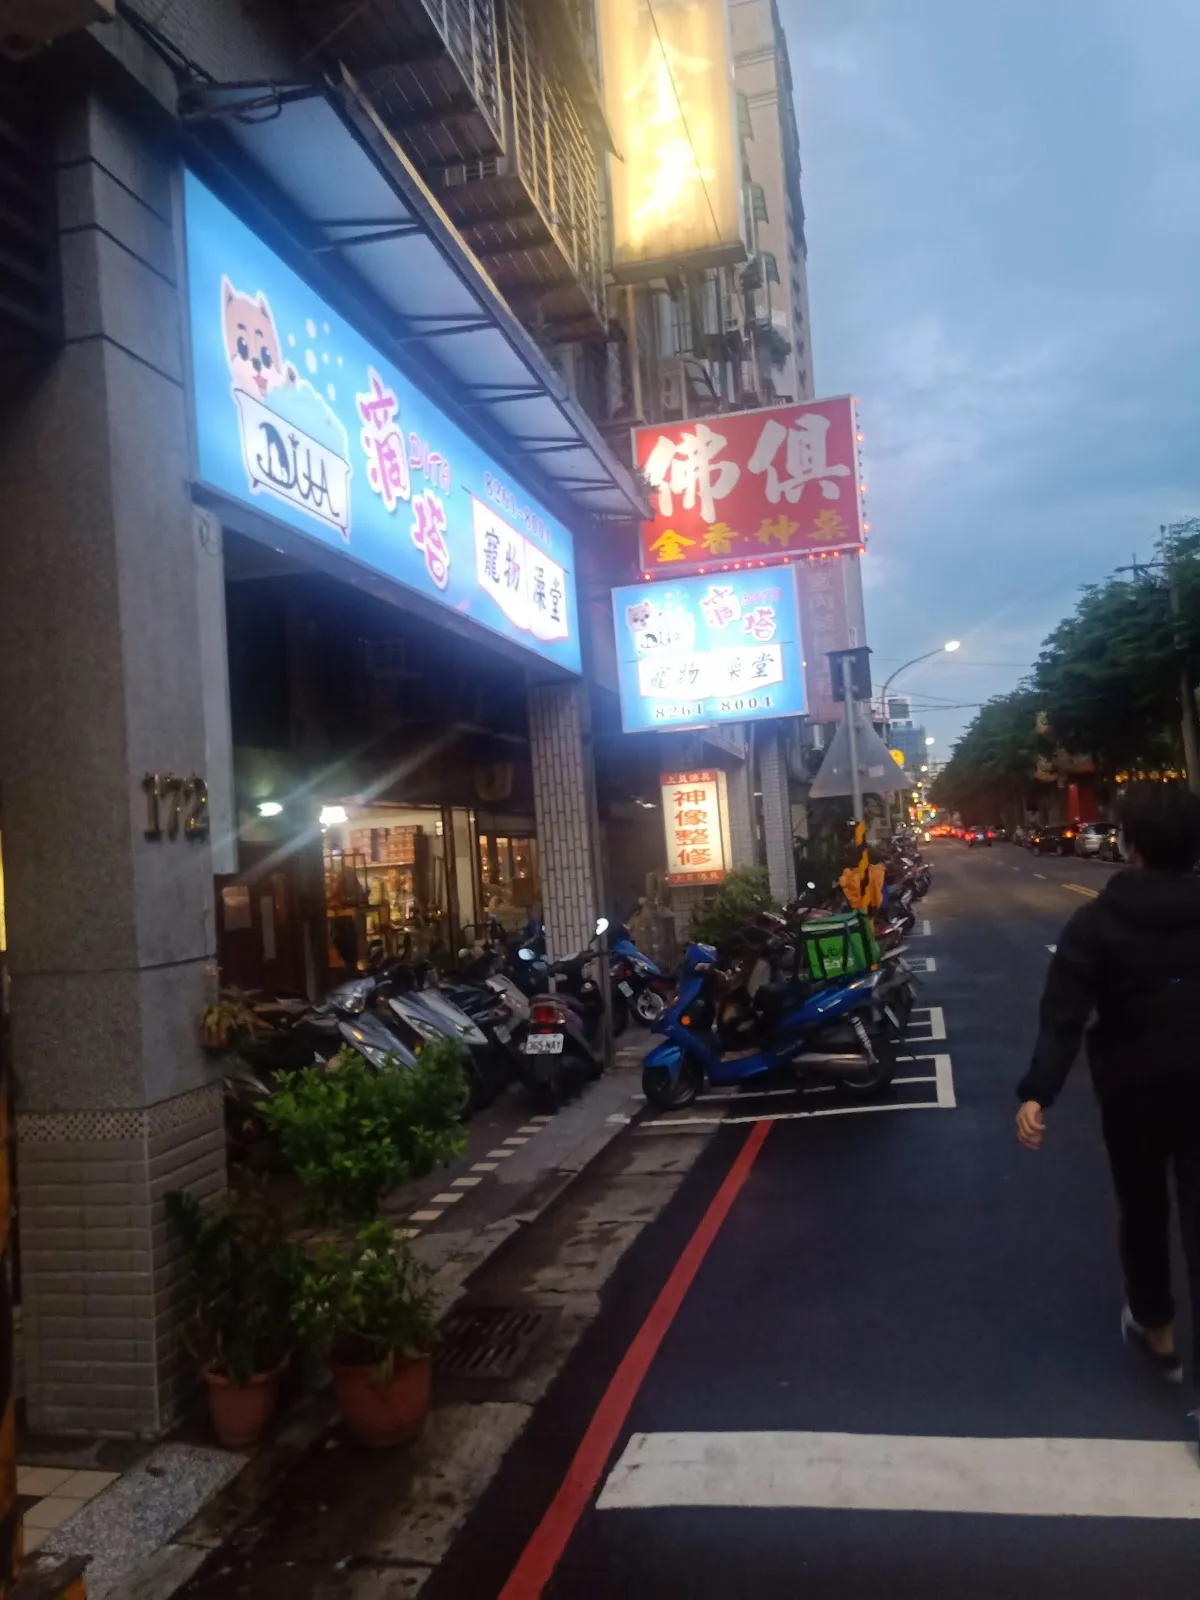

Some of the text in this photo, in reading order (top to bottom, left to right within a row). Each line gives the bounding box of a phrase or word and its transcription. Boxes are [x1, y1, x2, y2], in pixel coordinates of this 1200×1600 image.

[644, 413, 850, 523] 佛俱
[143, 772, 209, 843] 172
[672, 789, 712, 866] 神像整修
